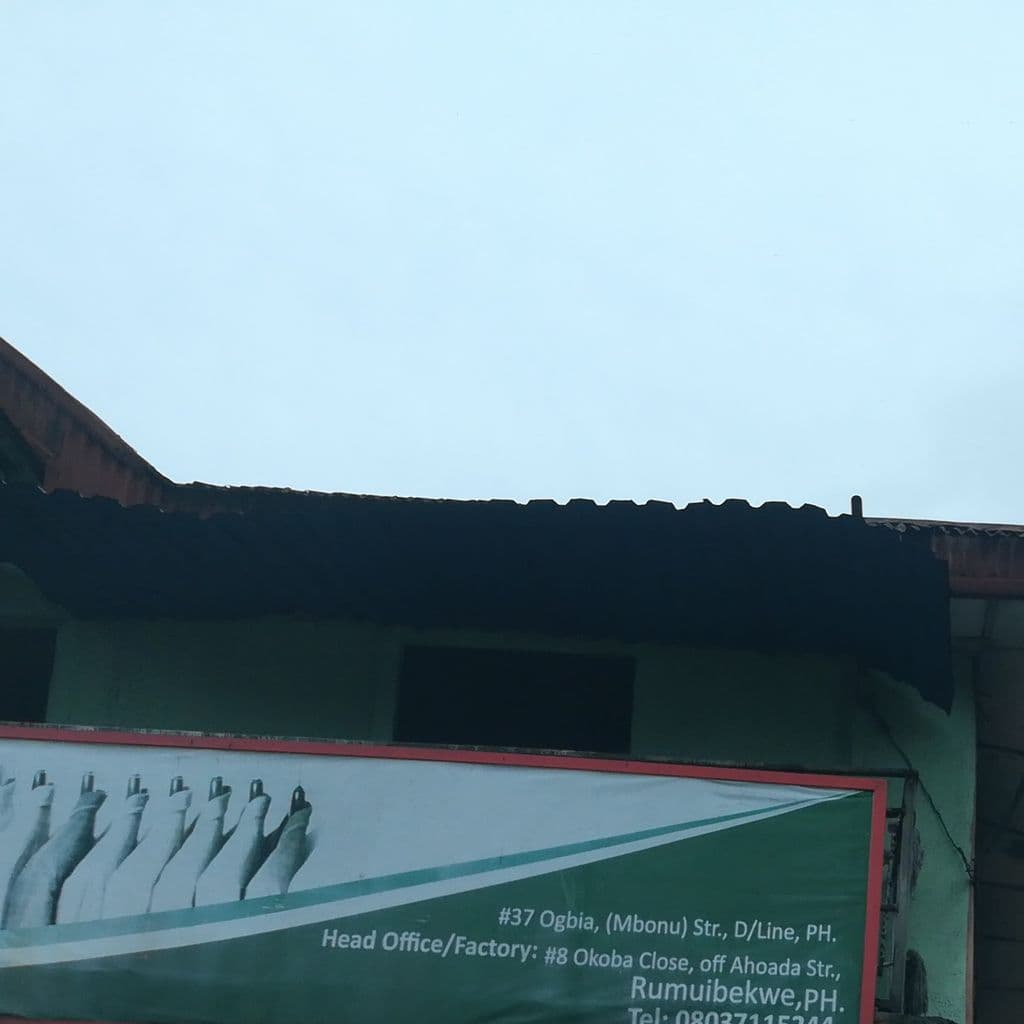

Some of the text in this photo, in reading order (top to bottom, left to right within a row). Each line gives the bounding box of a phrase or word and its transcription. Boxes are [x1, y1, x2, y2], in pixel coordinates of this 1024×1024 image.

[498, 907, 837, 945] #37 Ogbia, (Mbonu) Str., D/Line, PH.
[321, 929, 841, 982] Head Office/Factory: #8 Okoba Close, off Ahoada Str.,
